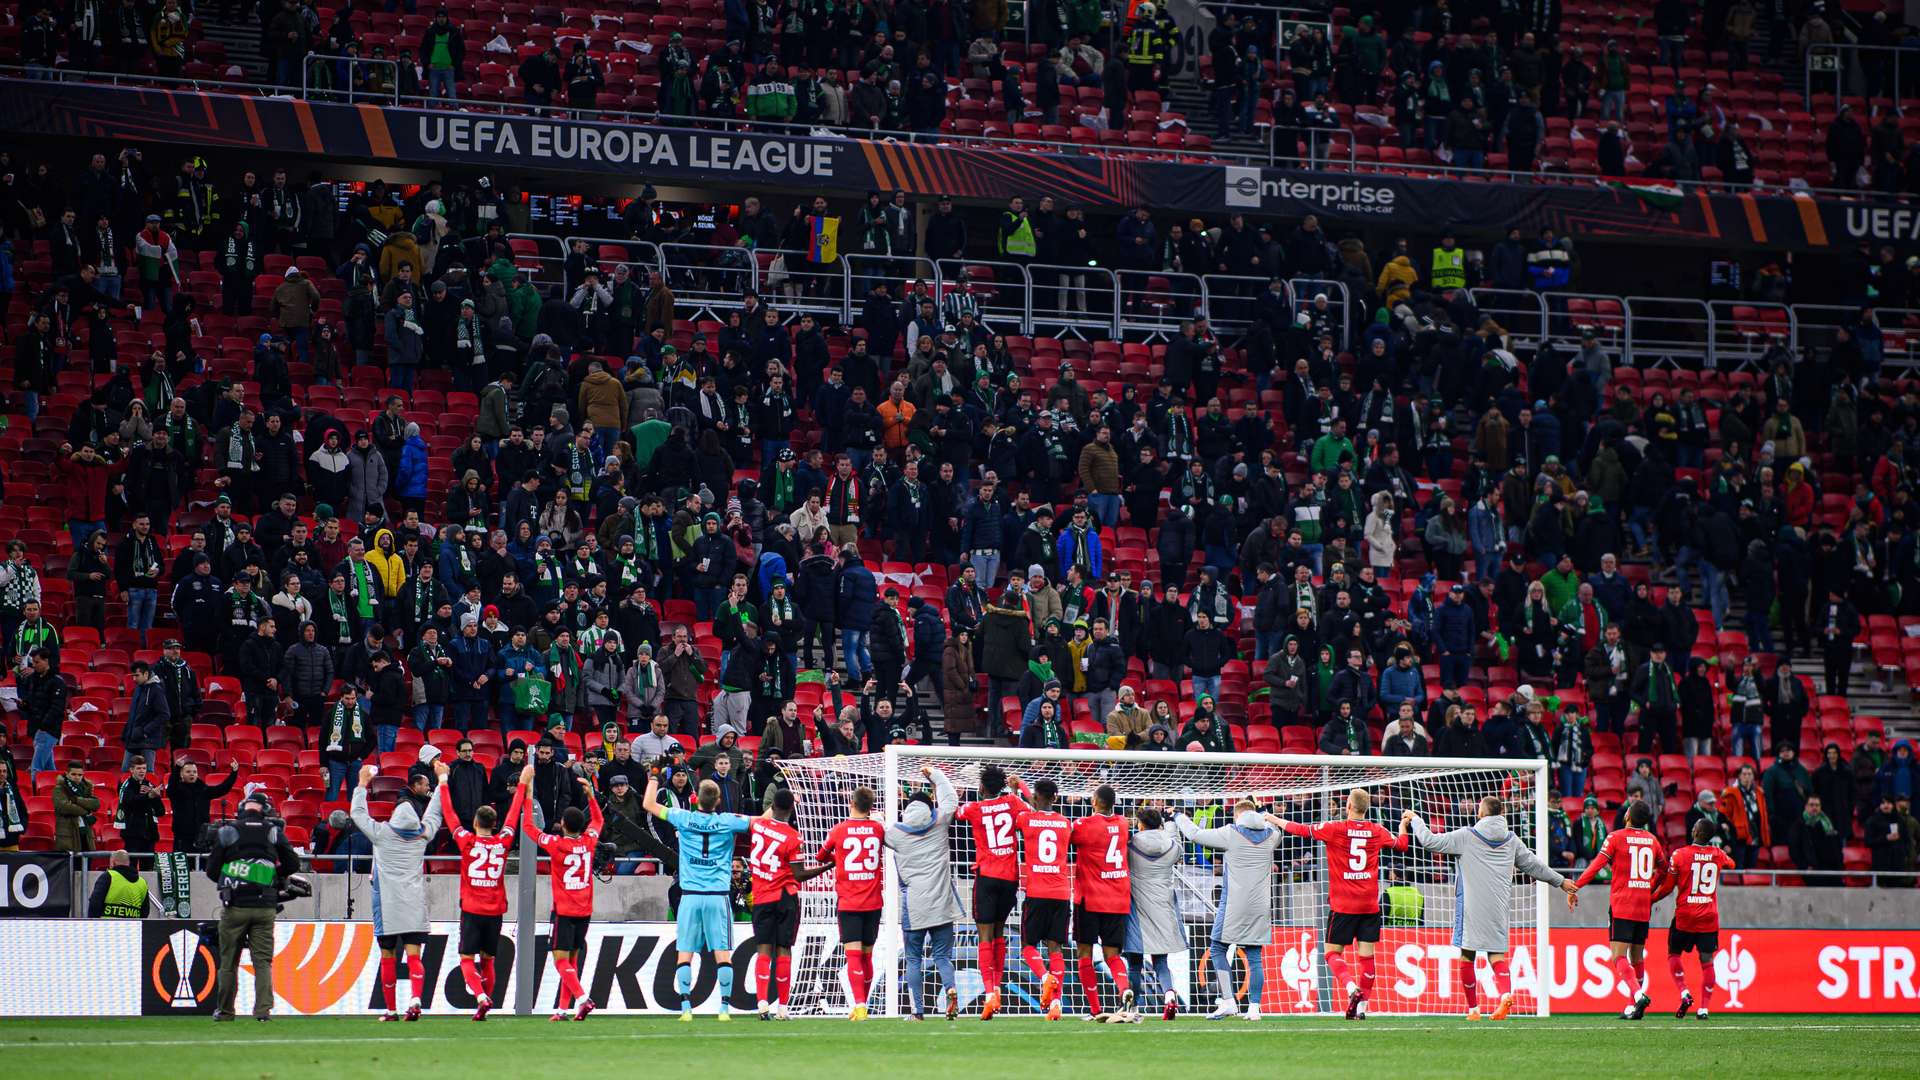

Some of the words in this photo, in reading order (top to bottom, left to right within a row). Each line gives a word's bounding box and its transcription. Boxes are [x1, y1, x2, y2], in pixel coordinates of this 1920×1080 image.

[419, 115, 521, 155] UEFA
[531, 124, 679, 168] EUROPA
[689, 135, 834, 177] LEAGUE
[1236, 176, 1395, 207] enterprise
[1336, 202, 1395, 214] rent-a-car
[981, 802, 1011, 814] TAPSOBA
[1029, 819, 1067, 828] KOSSOUNOU
[702, 832, 710, 858] 1
[982, 812, 1014, 849] 12
[1107, 825, 1120, 834] TAH
[1347, 829, 1373, 838] BAKKER
[750, 832, 782, 873] 24
[843, 836, 880, 871] 23
[991, 847, 1014, 856] AYER04
[1038, 829, 1058, 864] 6
[1105, 835, 1123, 869] 4
[1349, 837, 1367, 872] 5
[1694, 853, 1713, 861] DIABY
[468, 847, 506, 880] 25
[563, 852, 591, 884] 21
[848, 872, 876, 881] BAYER04
[1101, 869, 1128, 879] BAYER04
[1343, 871, 1372, 880] BAYER04
[1628, 845, 1653, 880] 10
[1690, 862, 1718, 895] 19
[1817, 945, 1920, 1000] STR
